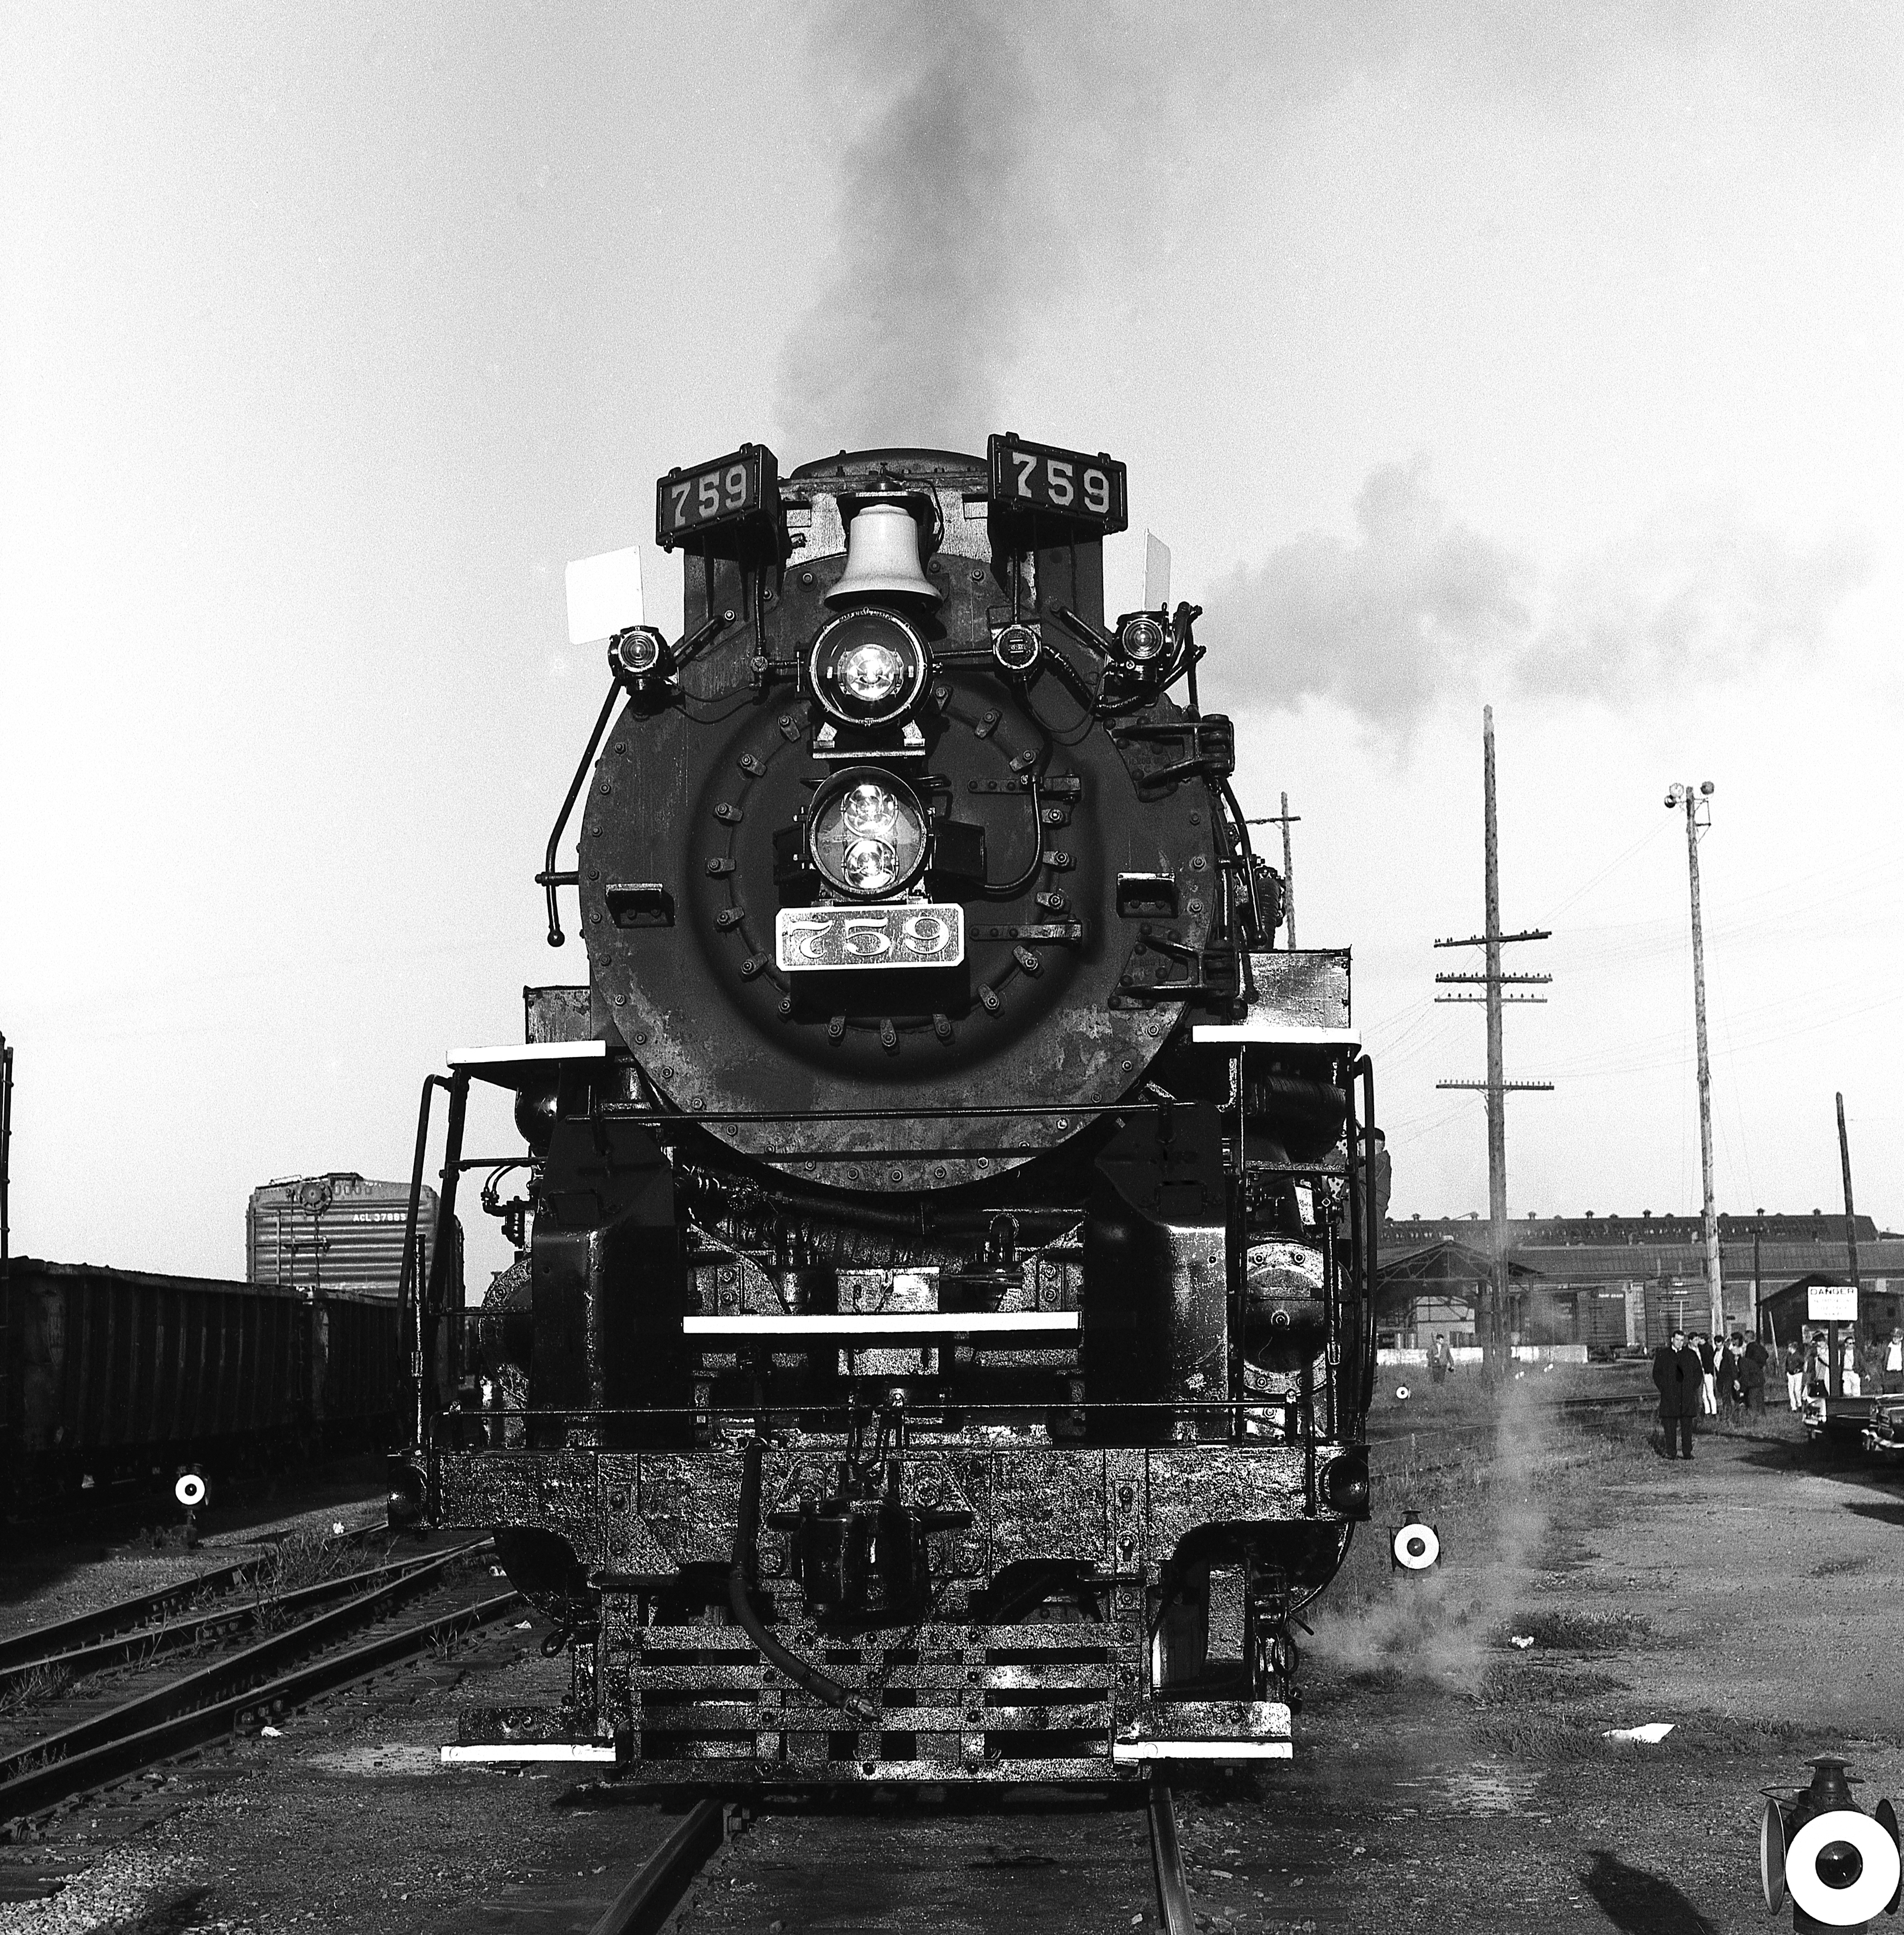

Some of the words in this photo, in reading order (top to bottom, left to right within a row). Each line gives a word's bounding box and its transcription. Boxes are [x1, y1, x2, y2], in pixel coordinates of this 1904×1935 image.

[672, 464, 747, 528] 759
[1012, 452, 1110, 513] 759
[790, 916, 950, 959] 759
[353, 1213, 371, 1222] ACL
